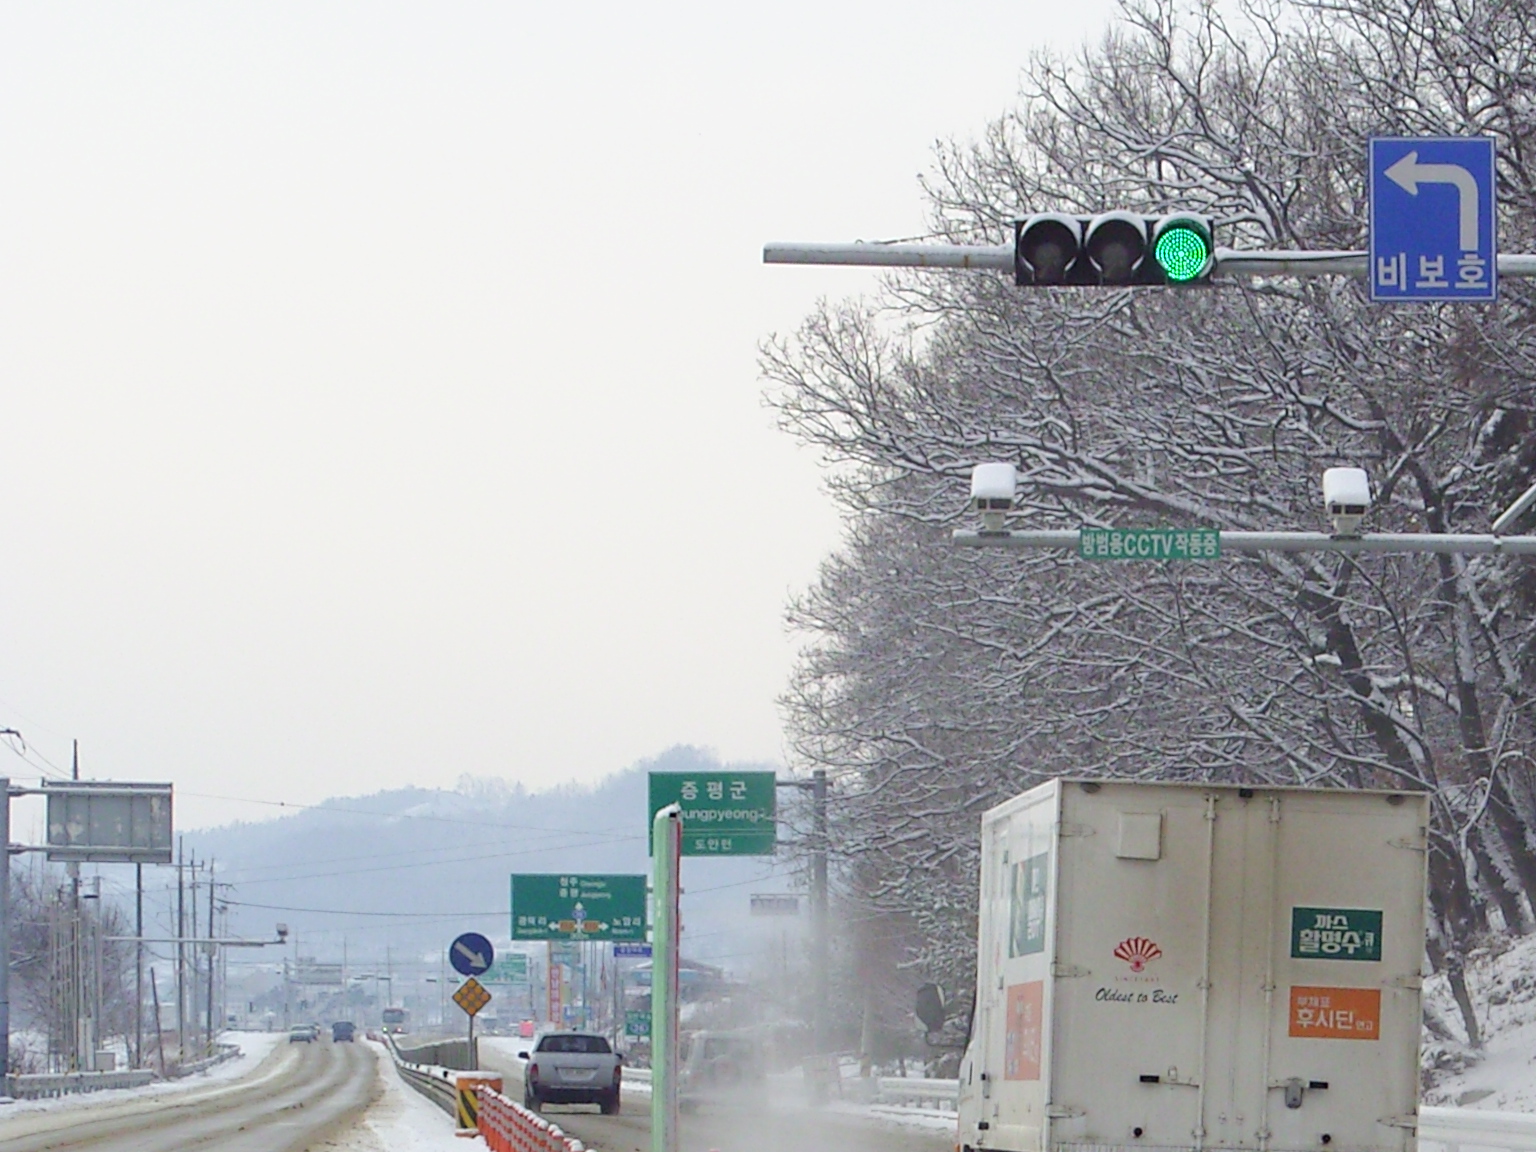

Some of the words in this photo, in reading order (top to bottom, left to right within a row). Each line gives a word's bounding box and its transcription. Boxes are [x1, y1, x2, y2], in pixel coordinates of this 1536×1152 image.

[1378, 252, 1488, 291] 비보호
[1081, 531, 1218, 557] 방범용CCTV작동중
[680, 780, 748, 801] 증평군
[1095, 987, 1134, 1003] Oldest
[1137, 992, 1149, 1004] to
[1152, 988, 1179, 1005] Best
[1296, 1008, 1354, 1031] 후시딘
